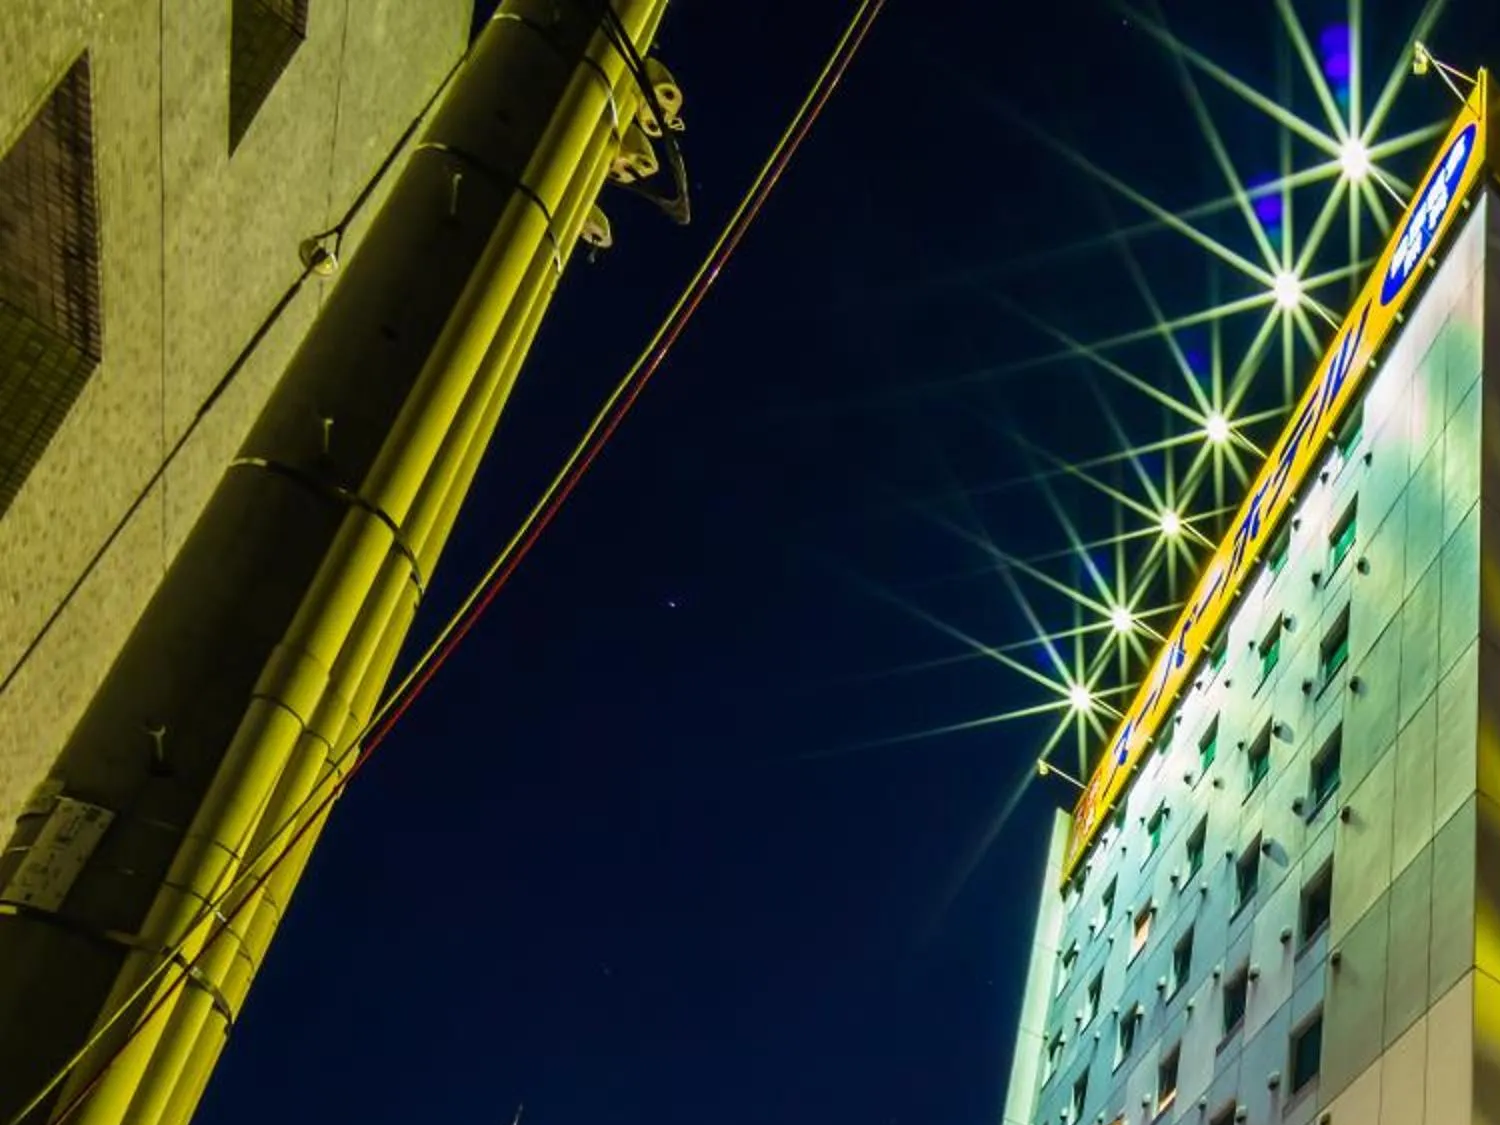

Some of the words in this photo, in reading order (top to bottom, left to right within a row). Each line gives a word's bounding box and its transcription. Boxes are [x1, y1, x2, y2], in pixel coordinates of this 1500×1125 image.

[1101, 298, 1374, 801] スーパーホテル
